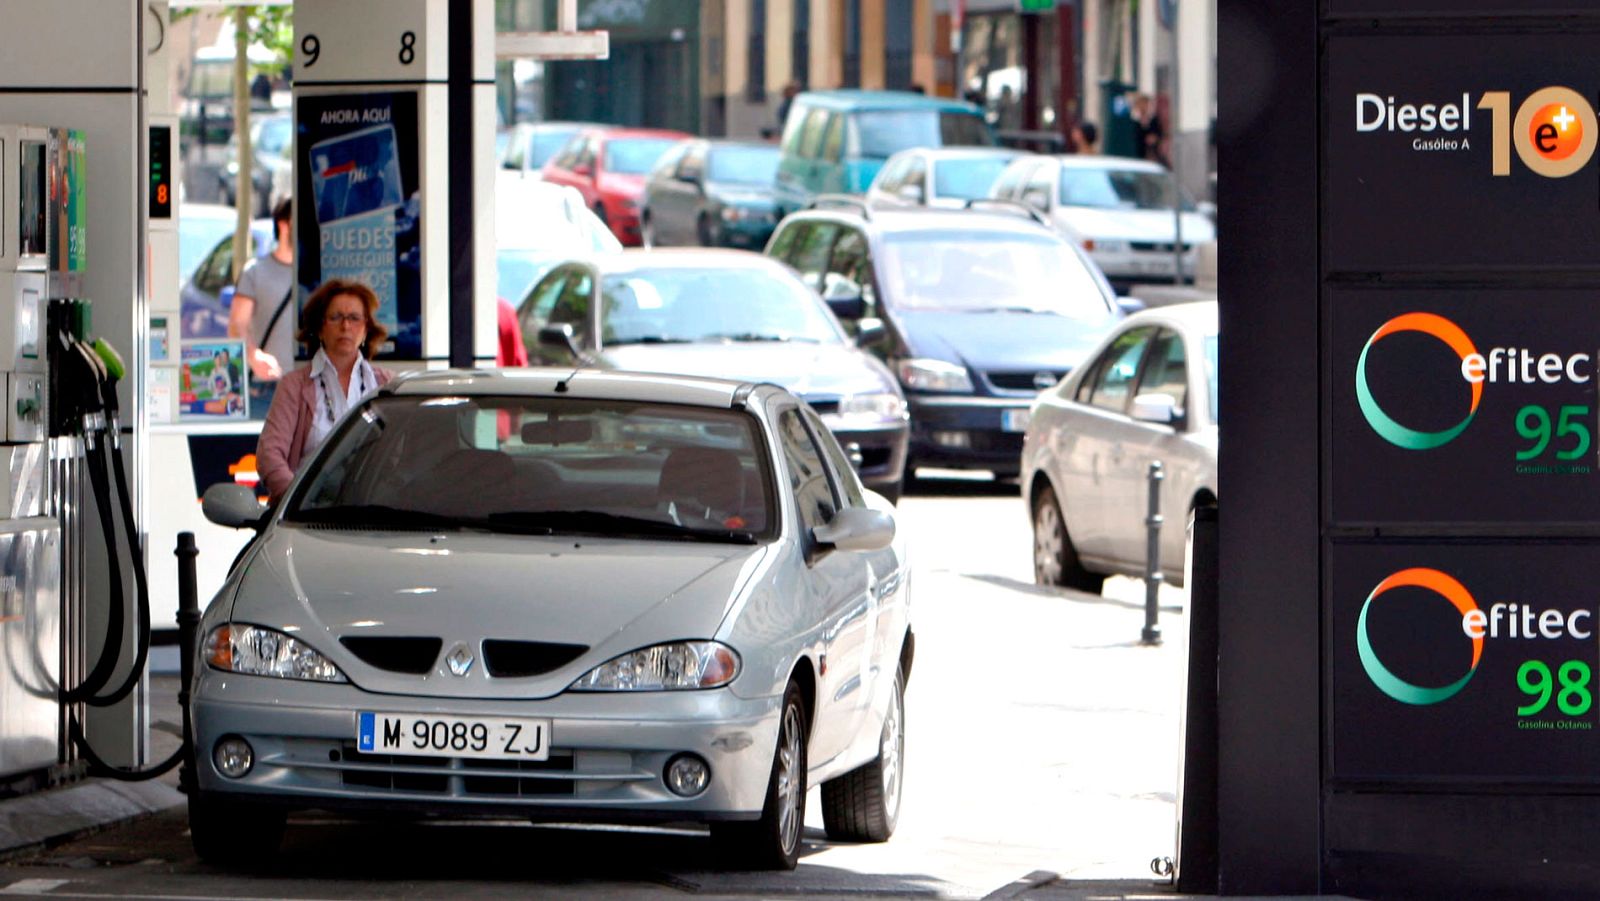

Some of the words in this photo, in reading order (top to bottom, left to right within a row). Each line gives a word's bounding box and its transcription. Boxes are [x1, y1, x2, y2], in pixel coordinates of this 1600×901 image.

[301, 34, 320, 68] 9
[398, 31, 416, 65] 8
[320, 109, 360, 124] AHORA
[1356, 92, 1470, 132] Diesel
[1477, 86, 1599, 178] 10
[1413, 137, 1458, 151] Gasóleo
[1461, 138, 1470, 150] A
[157, 183, 168, 205] 8
[321, 226, 394, 251] PUEDES
[321, 251, 394, 269] CONSEGUIR
[1461, 347, 1590, 383] efitec
[1515, 404, 1591, 461] 95
[1462, 603, 1591, 639] efitec
[1516, 659, 1592, 717] 98
[383, 717, 401, 749] M
[412, 719, 488, 752] 9089
[503, 722, 542, 755] ZJ
[1517, 719, 1554, 729] Gasolina
